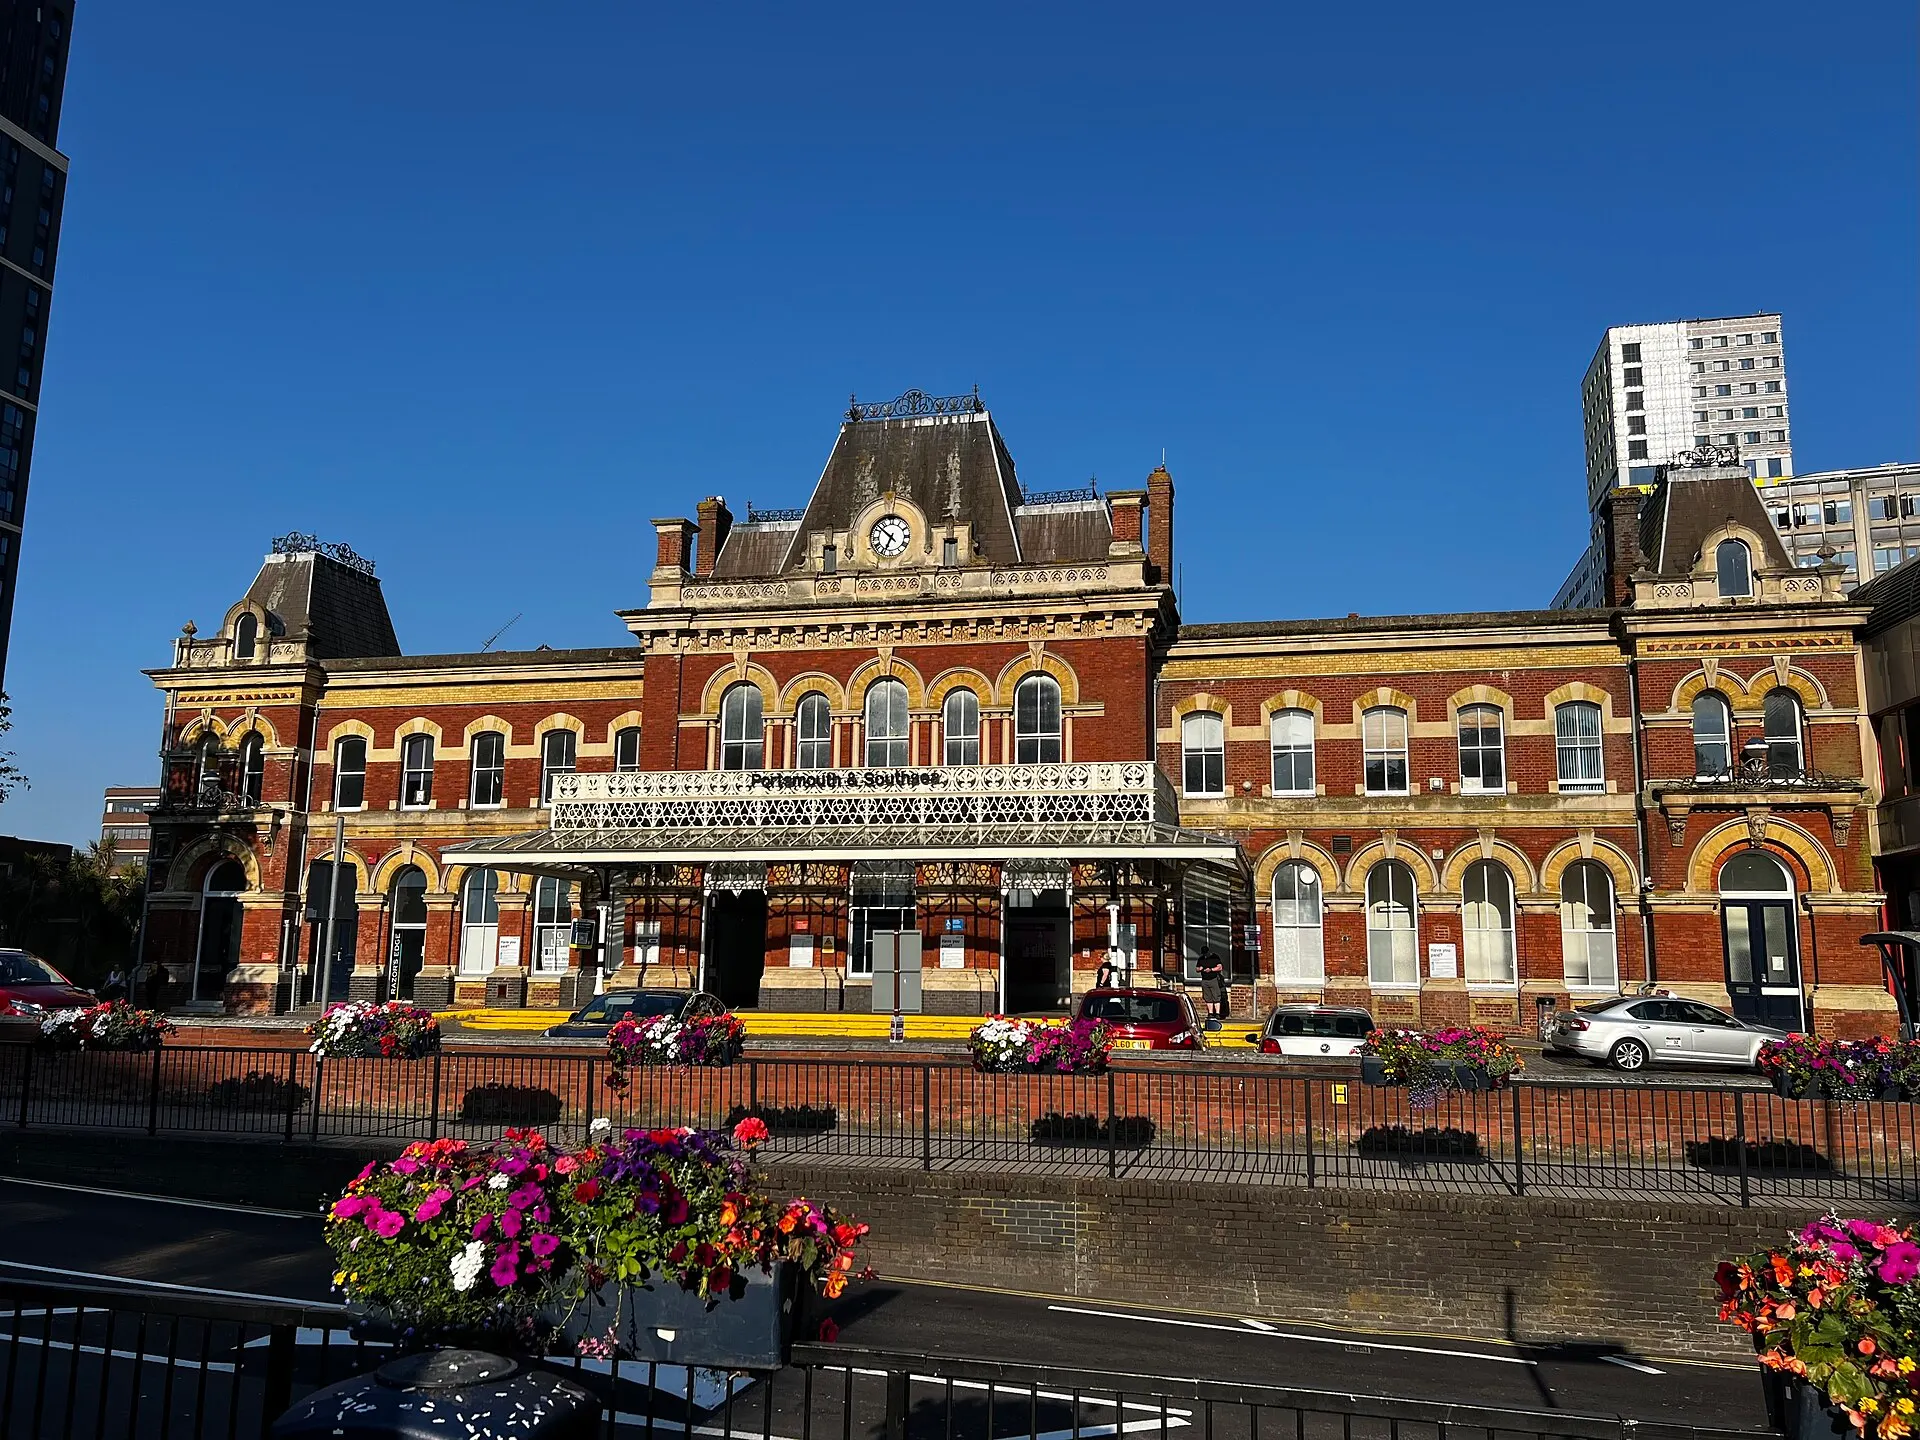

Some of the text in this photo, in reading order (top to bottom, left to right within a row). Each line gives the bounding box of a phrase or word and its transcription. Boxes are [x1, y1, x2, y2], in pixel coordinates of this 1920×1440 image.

[750, 770, 941, 788] Portsmouth & Southsea
[552, 931, 564, 939] TO
[550, 939, 565, 947] LET
[390, 933, 401, 995] RAZOR'S EDGE
